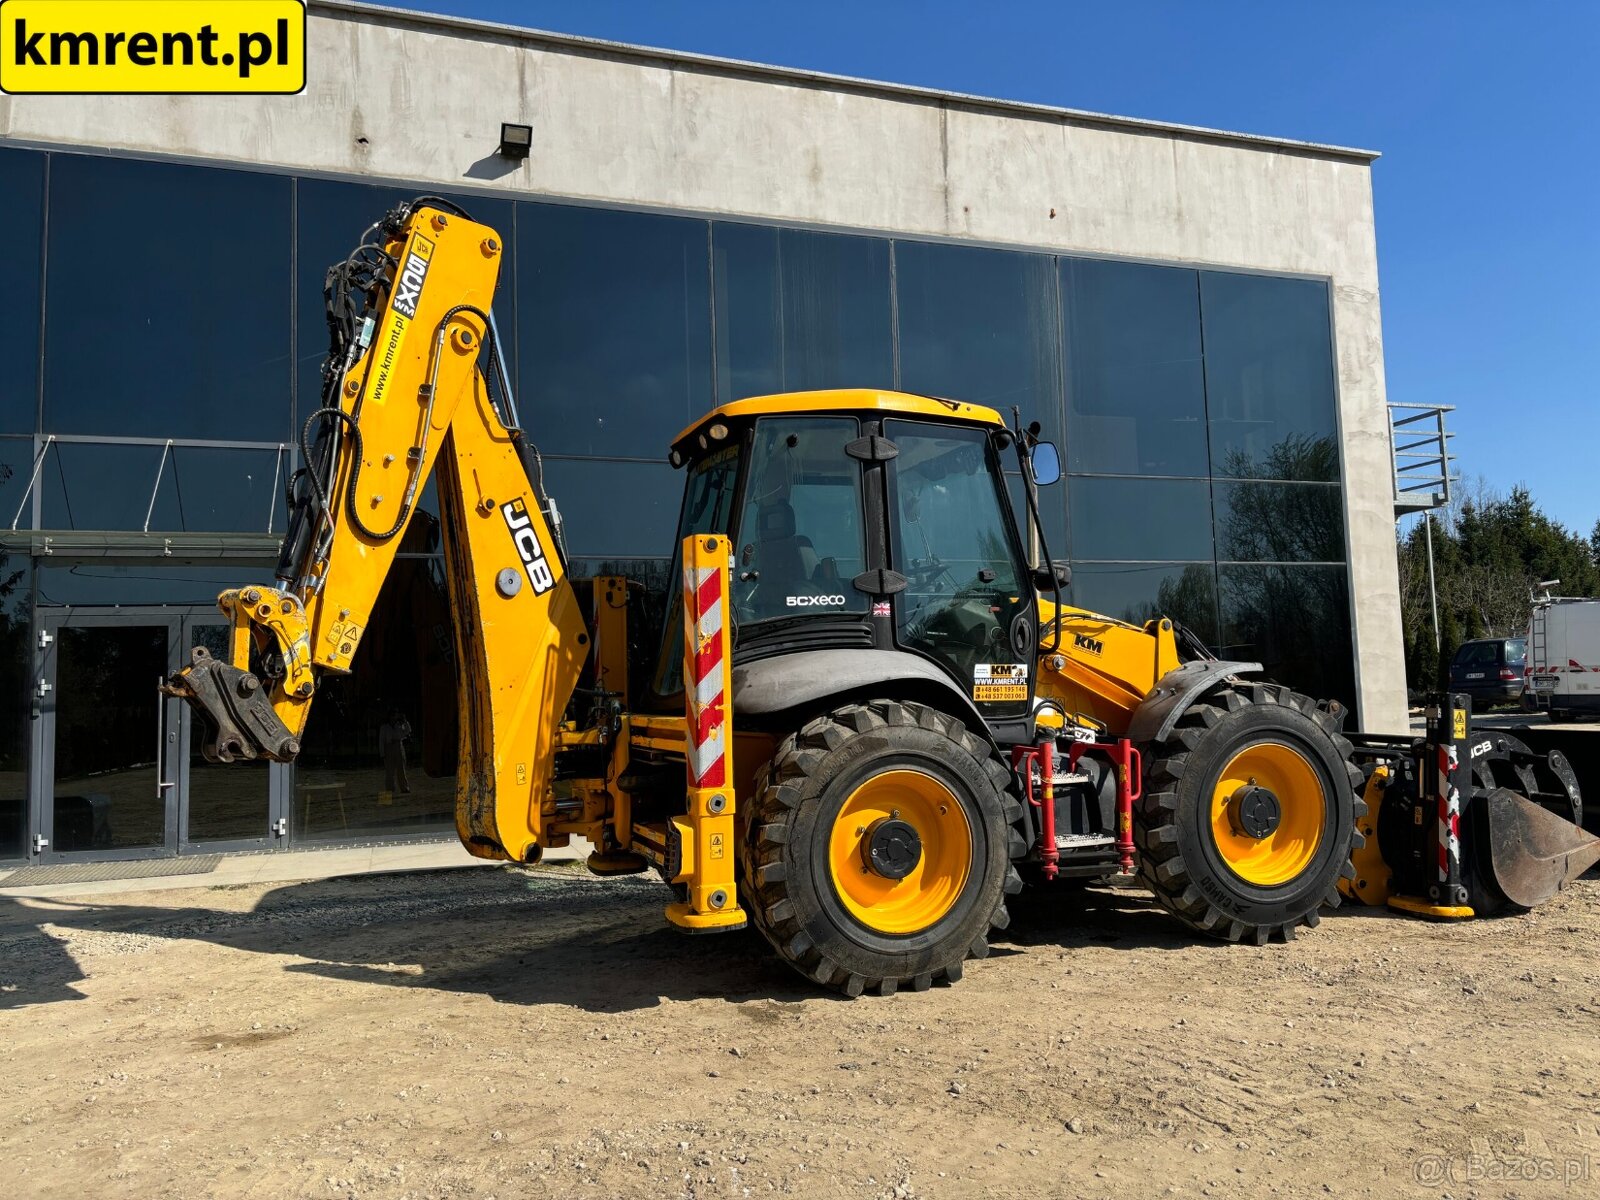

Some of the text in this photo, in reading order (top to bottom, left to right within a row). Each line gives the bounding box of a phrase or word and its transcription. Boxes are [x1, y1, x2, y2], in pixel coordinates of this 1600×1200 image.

[394, 253, 428, 317] 5CX WM
[373, 315, 405, 400] www.kmrent.pl
[503, 503, 554, 593] JCB
[991, 665, 1012, 675] KM
[1074, 633, 1103, 654] KM
